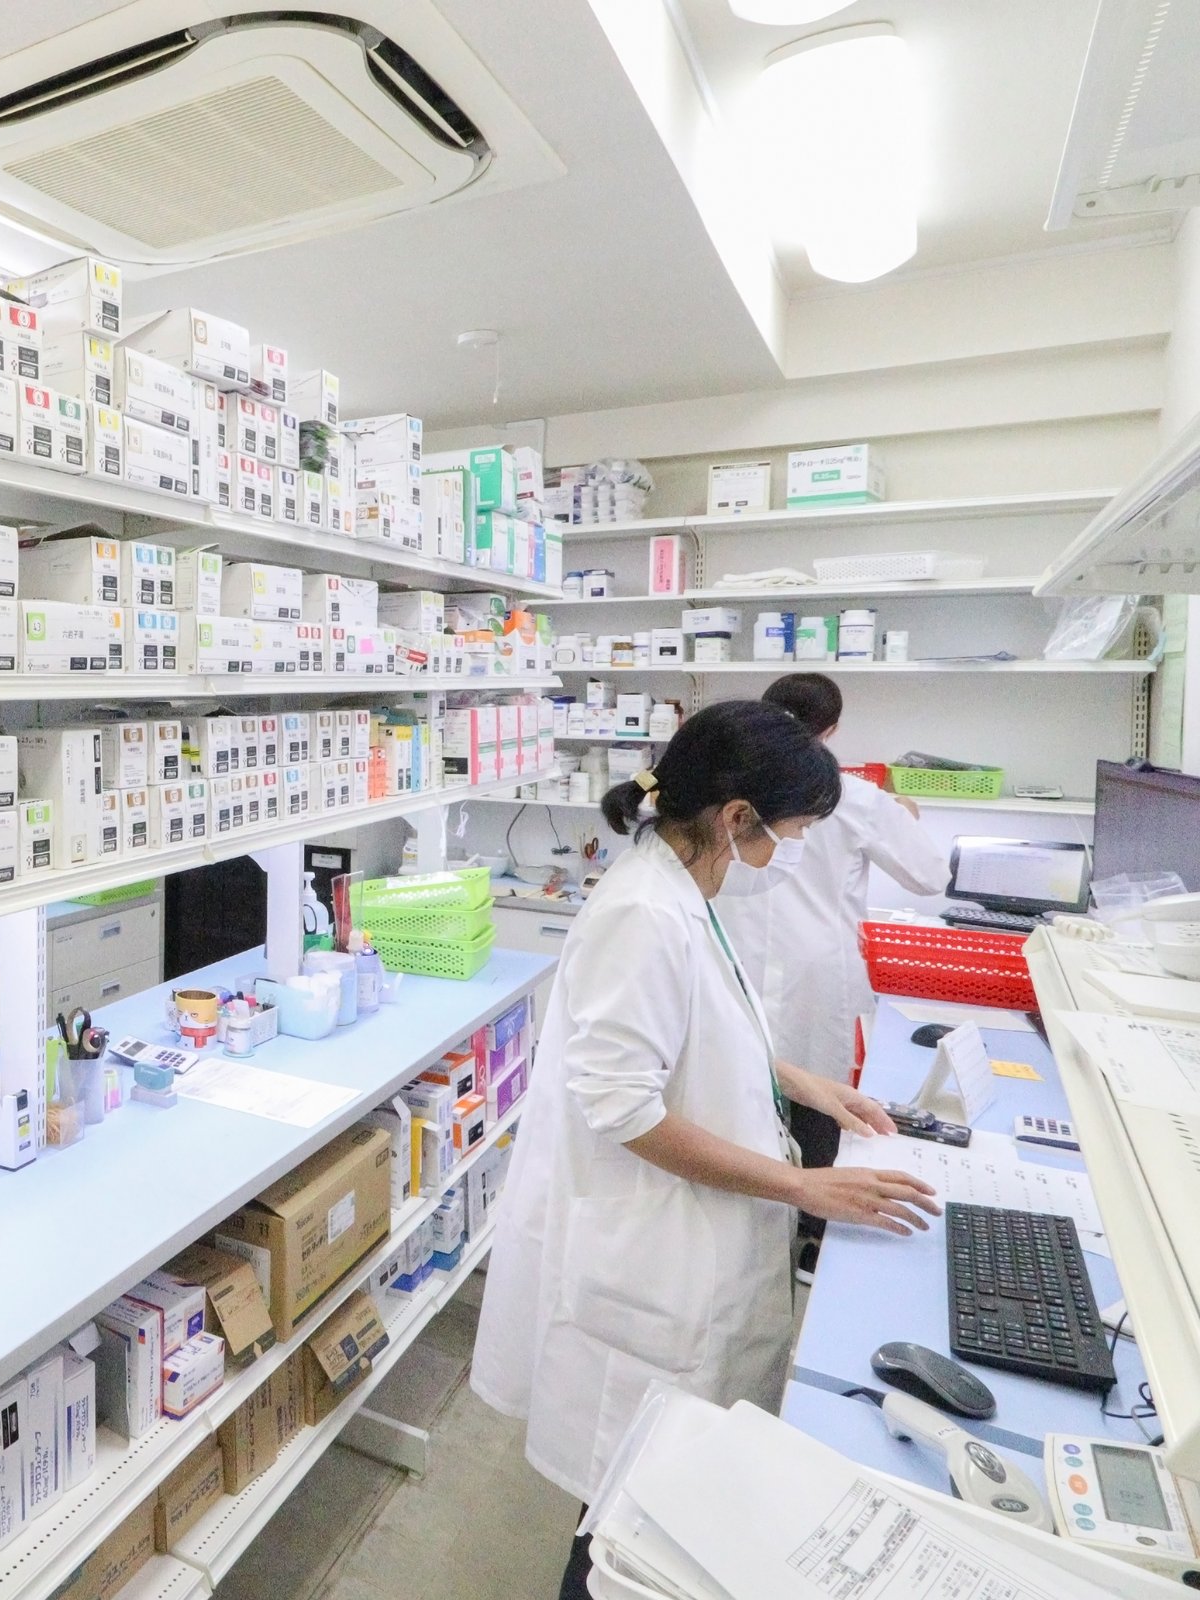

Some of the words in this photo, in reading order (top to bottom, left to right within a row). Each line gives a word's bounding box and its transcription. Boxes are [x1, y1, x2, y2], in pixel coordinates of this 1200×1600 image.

[34, 1431, 43, 1504] ケトプロフェンテープ
